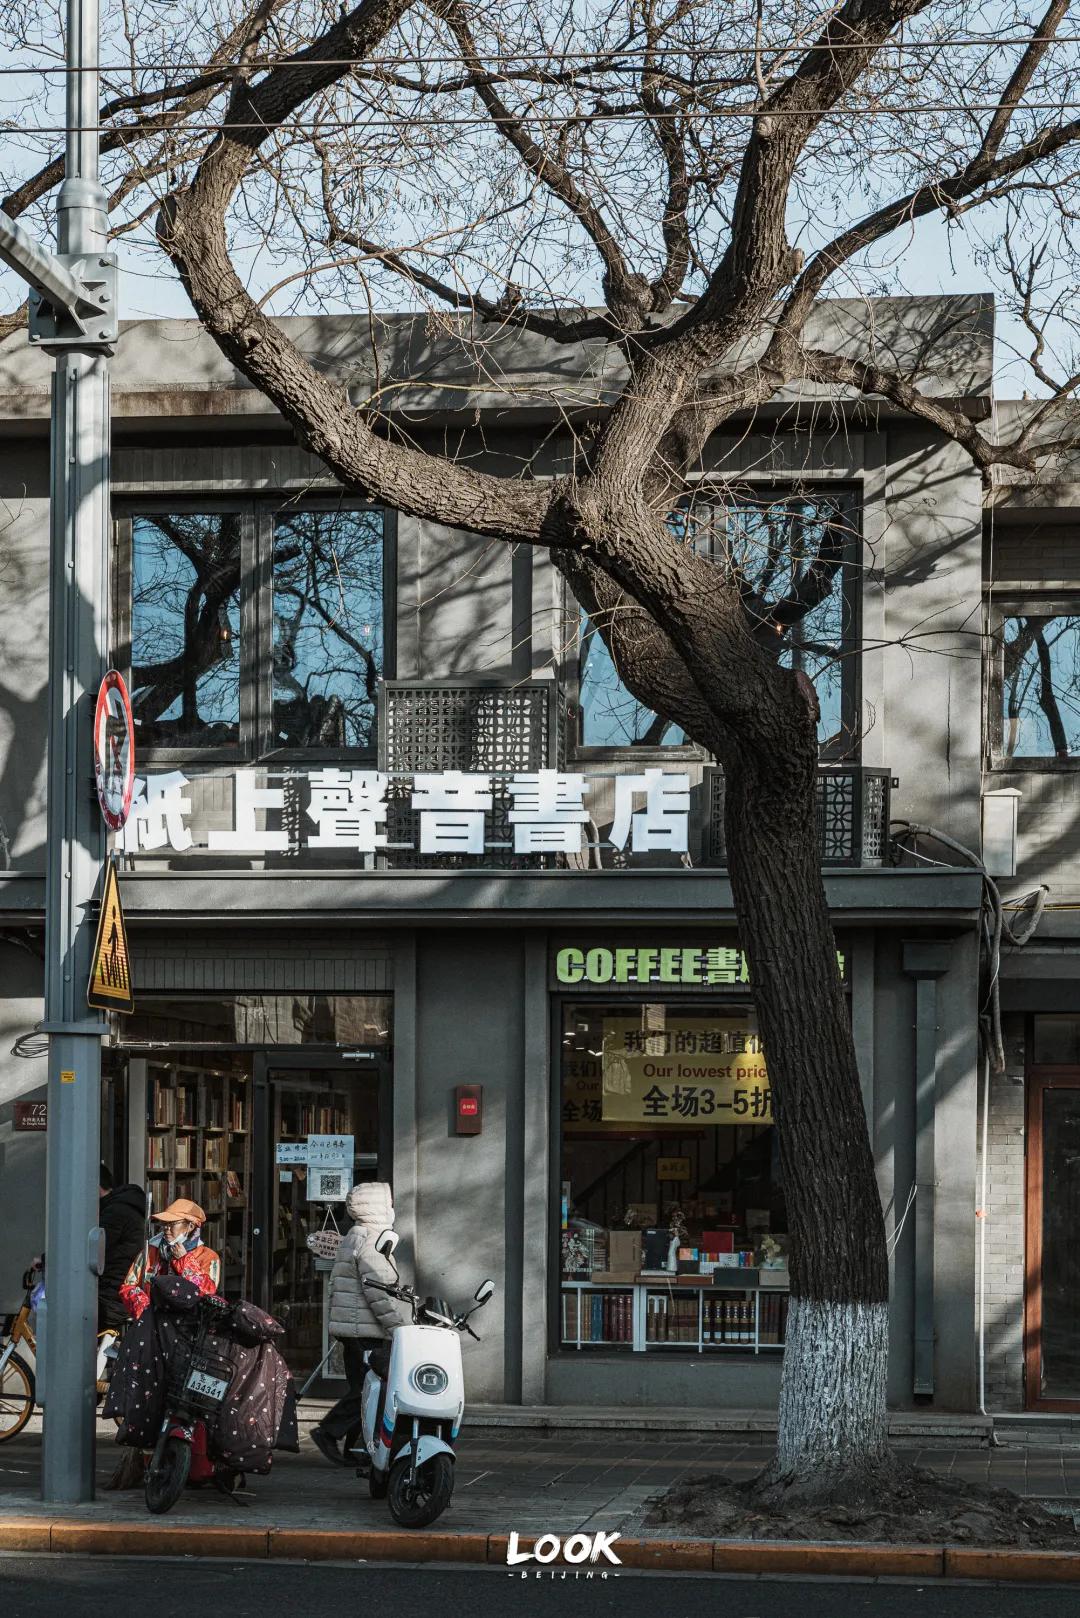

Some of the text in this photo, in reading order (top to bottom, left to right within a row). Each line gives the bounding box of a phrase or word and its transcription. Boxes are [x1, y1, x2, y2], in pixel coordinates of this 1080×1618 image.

[115, 768, 690, 855] 紙上聲音書店
[556, 946, 750, 984] COFFEE書
[643, 1063, 767, 1080] Our lowest pric
[190, 1380, 222, 1398] A34341
